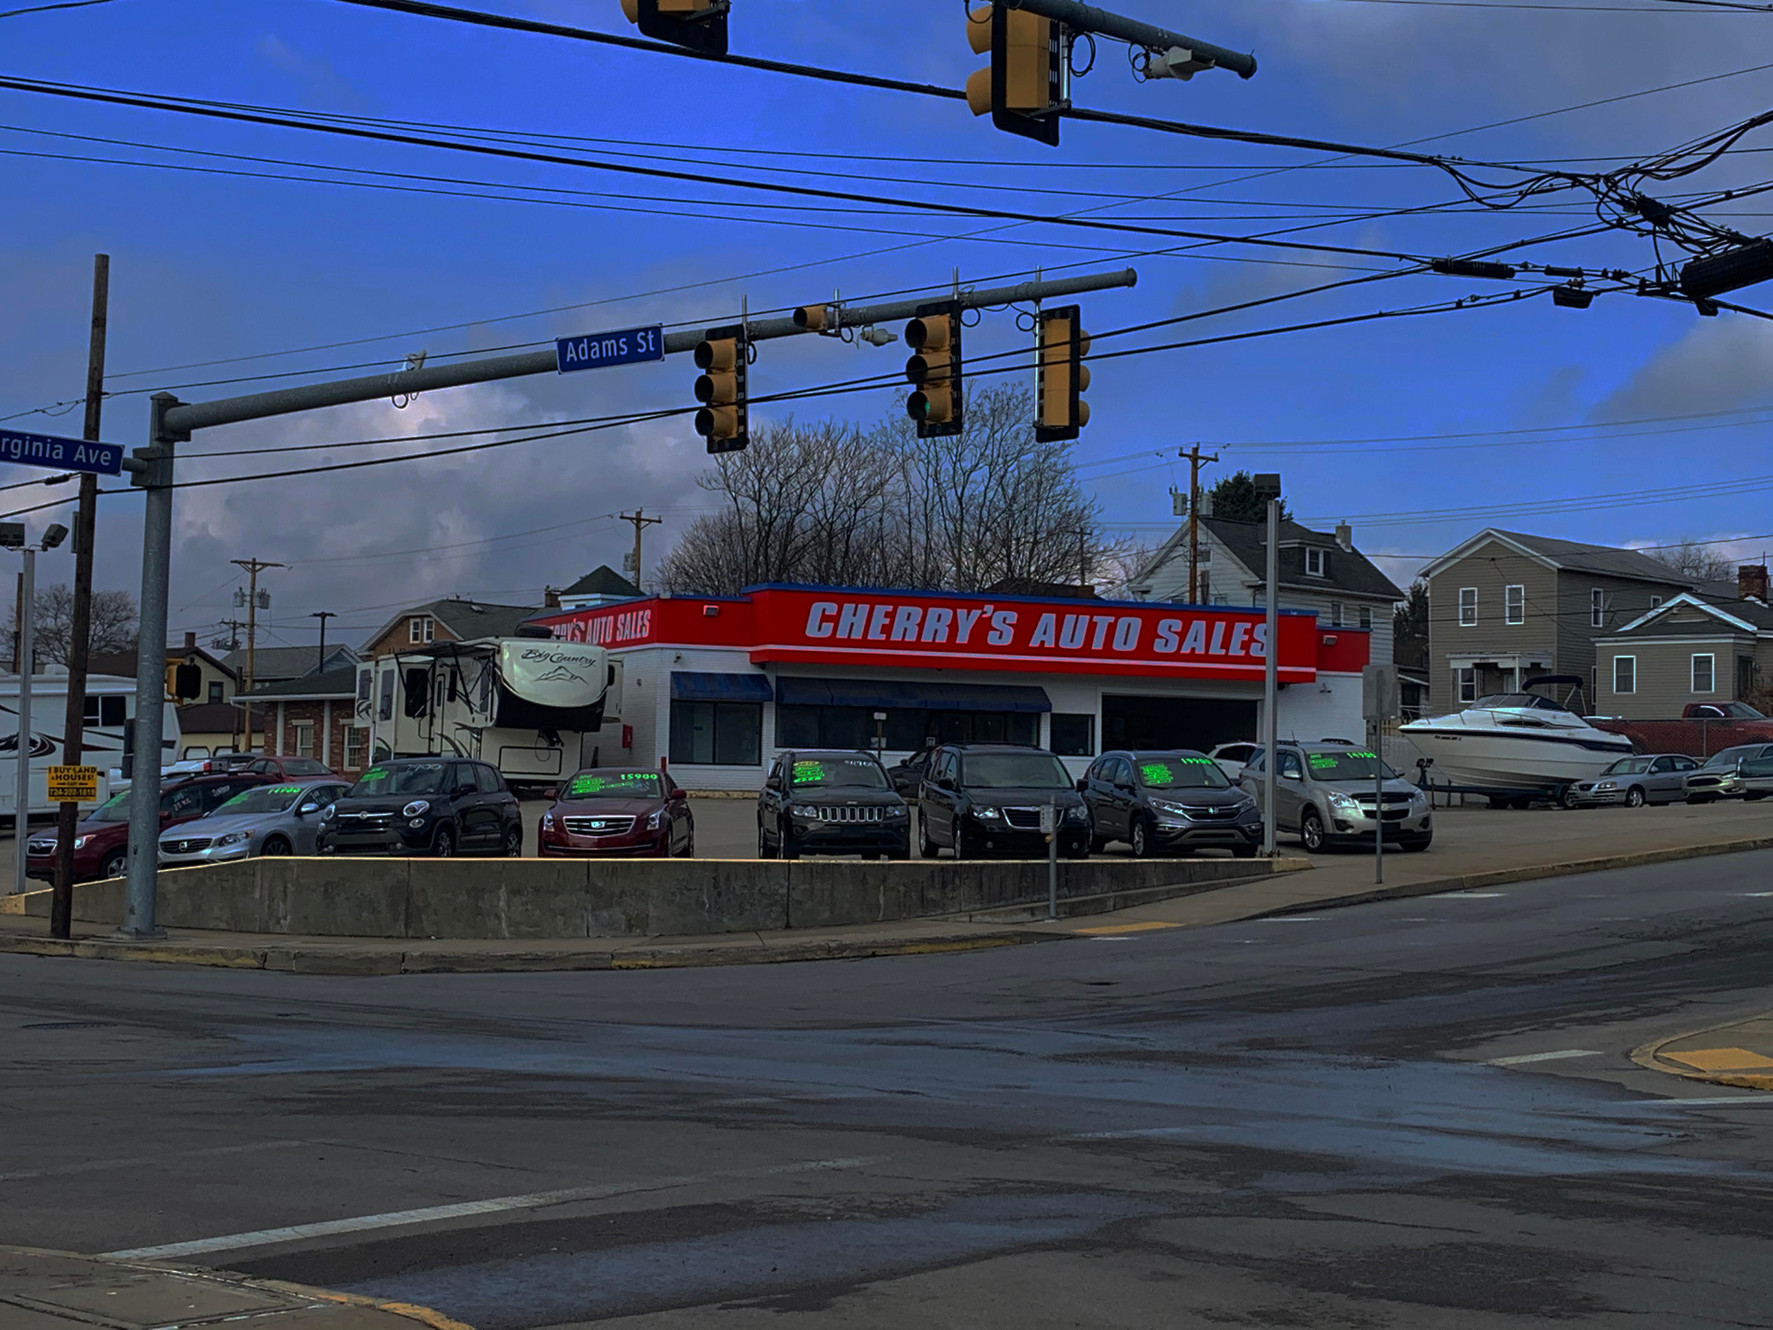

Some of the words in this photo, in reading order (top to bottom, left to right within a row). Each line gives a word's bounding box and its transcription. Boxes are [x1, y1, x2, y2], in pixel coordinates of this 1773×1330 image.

[566, 337, 628, 363] Adams
[637, 330, 655, 353] St
[73, 444, 112, 466] Ave
[586, 615, 614, 644] AUTO
[615, 609, 652, 642] SALES
[805, 601, 1018, 646] CHERRY'S
[1029, 613, 1143, 651] AUTO
[1153, 618, 1268, 657] SALES
[521, 648, 550, 663] Big
[549, 652, 596, 668] Country
